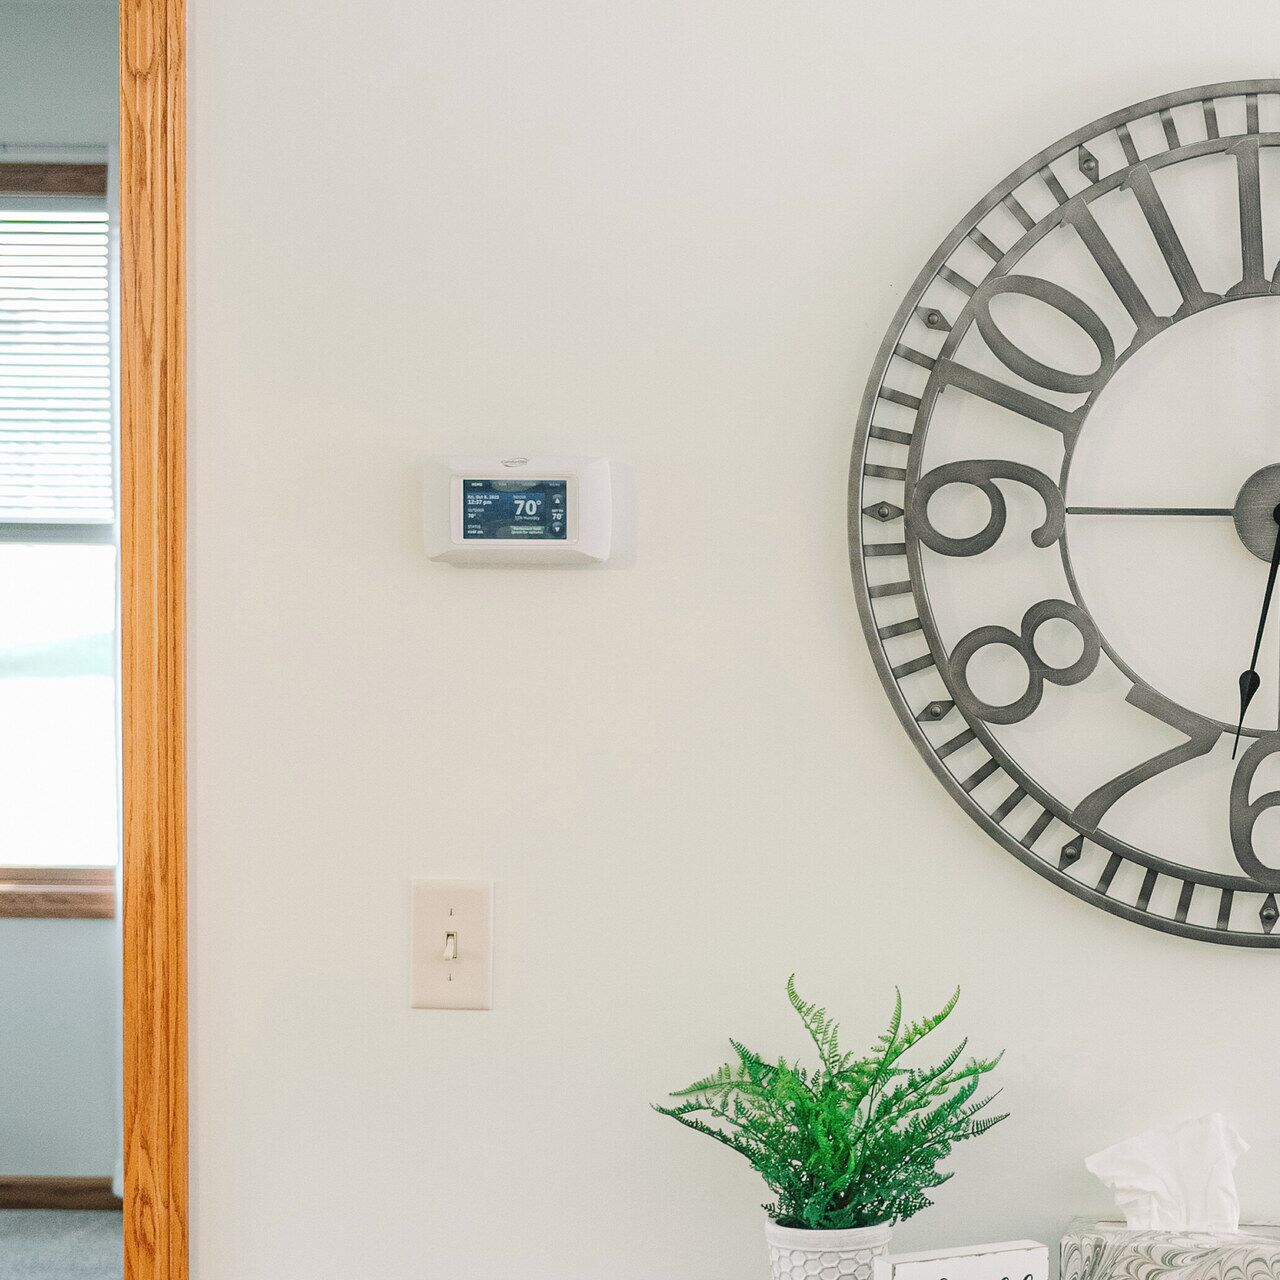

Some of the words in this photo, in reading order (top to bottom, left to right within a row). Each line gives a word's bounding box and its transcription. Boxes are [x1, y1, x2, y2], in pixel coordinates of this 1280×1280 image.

[1060, 163, 1223, 340] 11
[939, 274, 1116, 449] 10
[514, 500, 542, 515] 70°
[913, 459, 1067, 557] 9
[949, 599, 1101, 724] 8
[1070, 683, 1223, 833] 7
